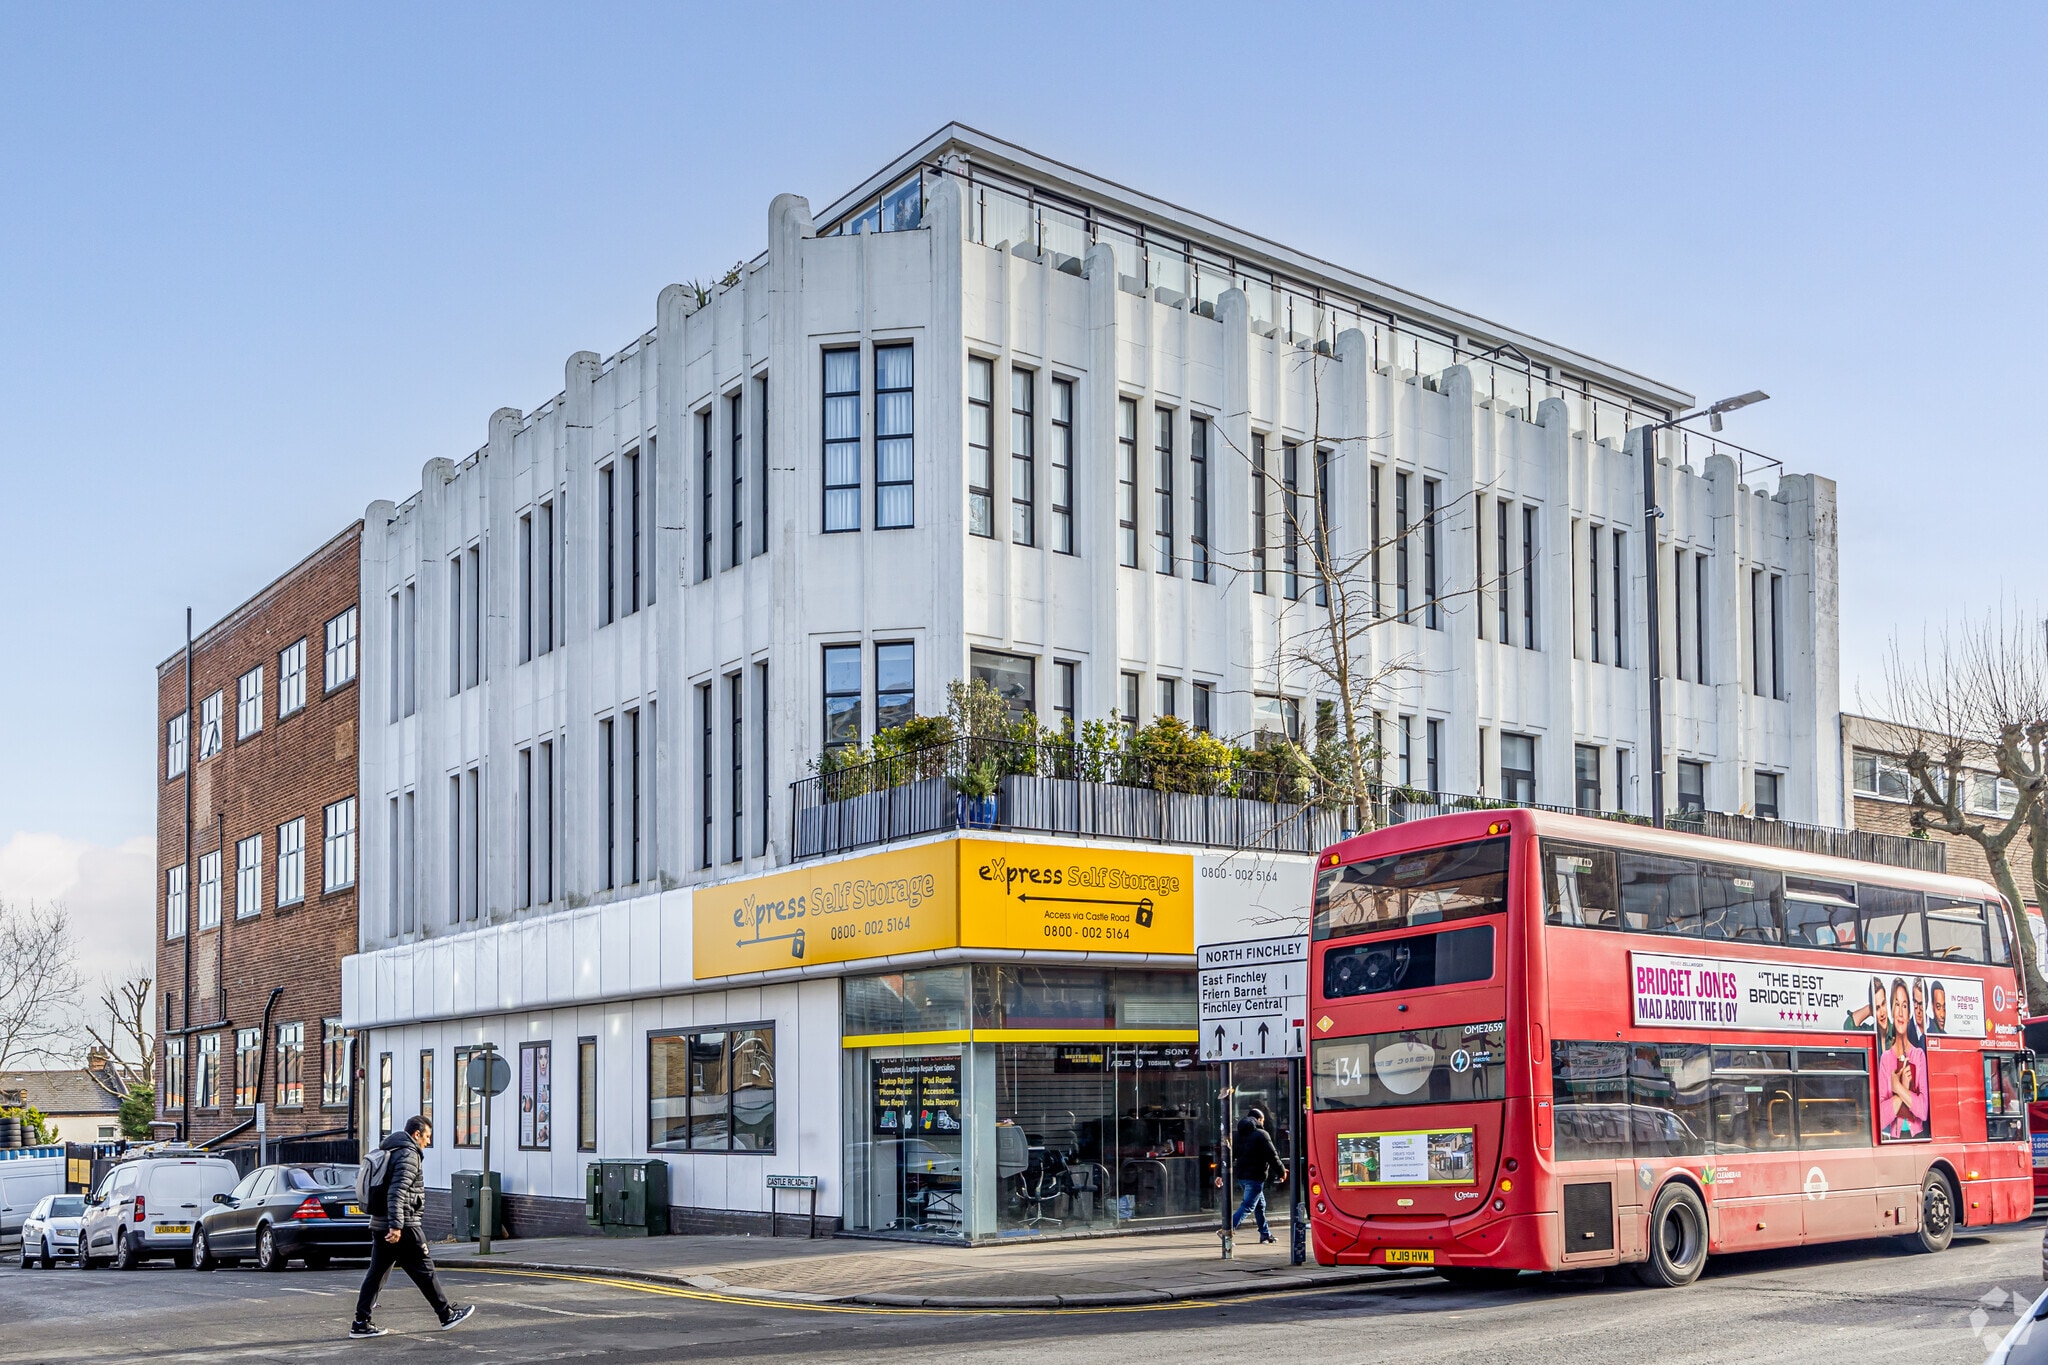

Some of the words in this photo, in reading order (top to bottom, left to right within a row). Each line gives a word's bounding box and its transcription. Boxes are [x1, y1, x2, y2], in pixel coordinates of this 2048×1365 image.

[1201, 867, 1226, 879] 0800
[1235, 869, 1253, 881] 002
[1256, 870, 1278, 883] 5164
[1044, 911, 1070, 920] Access
[1072, 912, 1083, 921] via
[1086, 912, 1108, 921] Castle
[1110, 912, 1130, 922] Road
[831, 924, 856, 941] 0800
[864, 920, 883, 935] 002
[887, 916, 911, 932] 5164
[1044, 926, 1072, 938] 0800
[1082, 927, 1102, 938] 002
[1105, 927, 1130, 939] 5164
[1206, 948, 1242, 963] NORTH
[1247, 943, 1301, 959] FINCHLEY
[1202, 974, 1223, 986] East
[1226, 971, 1267, 983] Finchley
[1636, 966, 1692, 997] BRIDGET
[1696, 970, 1738, 999] JONES
[1792, 974, 1824, 990] BEST
[1202, 988, 1230, 1000] Friern
[1234, 984, 1267, 997] Barnet
[1749, 988, 1804, 1006] BRIDGET
[1203, 1000, 1242, 1014] Finchley
[1245, 997, 1283, 1010] Central
[1957, 995, 1979, 1004] CINEMAS
[1638, 998, 1663, 1019] MAD
[1665, 999, 1697, 1021] ABOUT
[1698, 1001, 1717, 1022] THE
[1464, 1022, 1503, 1034] OME2659
[881, 1066, 901, 1074] Computer
[920, 1064, 933, 1073] Repair
[934, 1063, 956, 1072] Specialists
[1335, 1056, 1362, 1087] 134
[879, 1077, 896, 1086] Laptop
[923, 1076, 934, 1084] iPad
[936, 1076, 952, 1085] Repair
[923, 1087, 955, 1095] Accessories
[923, 1098, 934, 1106] Data
[936, 1098, 960, 1107] Recovery
[767, 1177, 786, 1186] CASTLE
[787, 1178, 801, 1186] ROAD
[1390, 1250, 1409, 1261] YJ19
[1412, 1250, 1429, 1261] HVM
